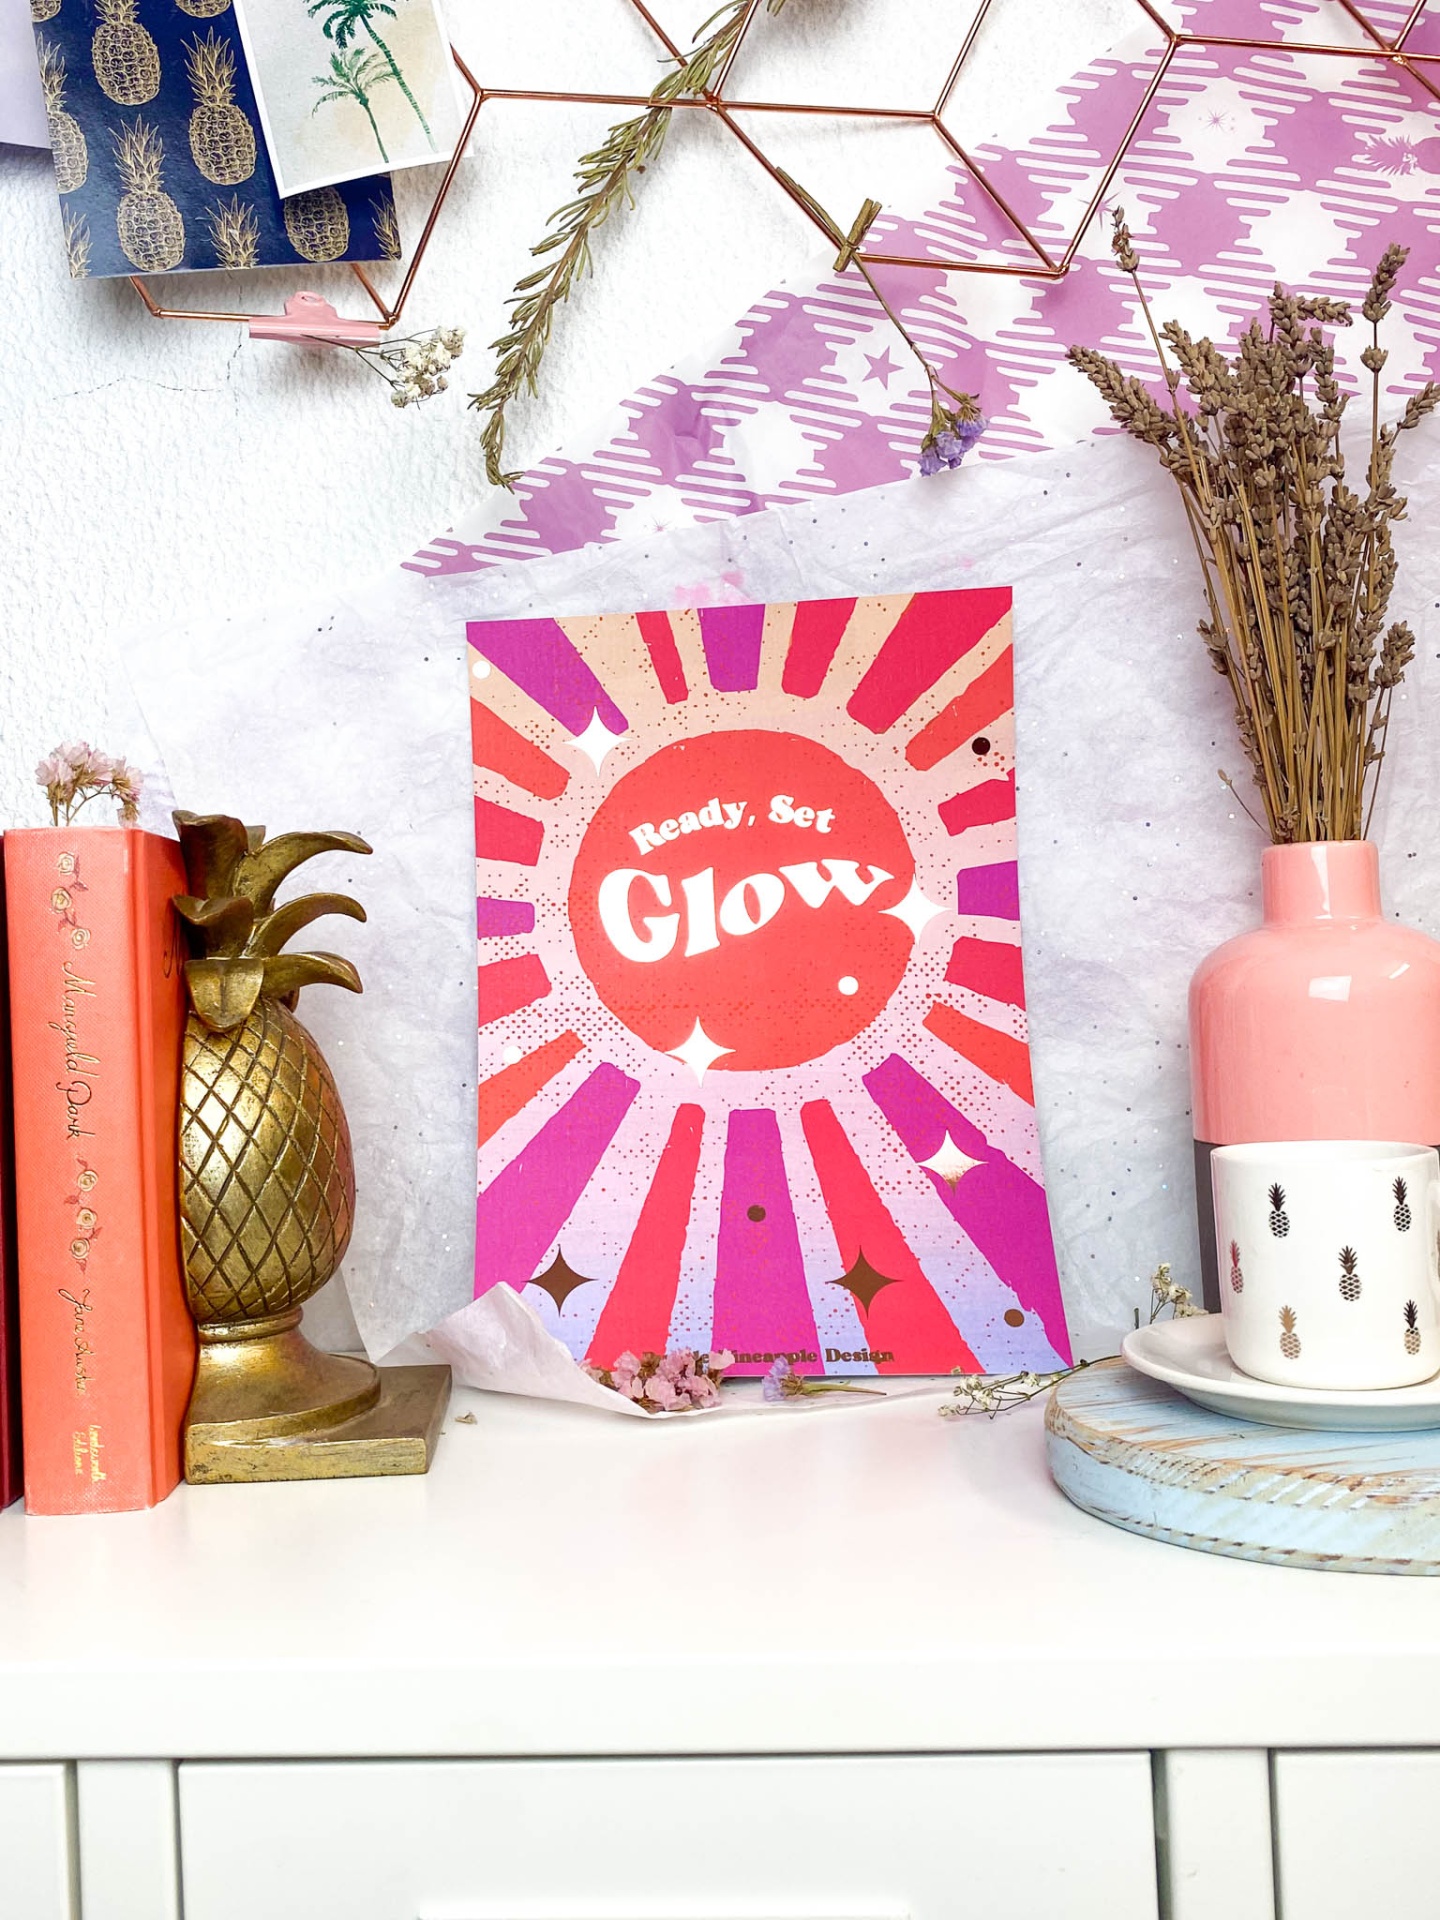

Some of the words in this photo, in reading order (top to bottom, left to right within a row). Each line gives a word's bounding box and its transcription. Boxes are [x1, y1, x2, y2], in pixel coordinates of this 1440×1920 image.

[628, 797, 756, 856] Ready,
[768, 794, 836, 833] Set
[598, 858, 895, 963] Glow
[55, 1080, 97, 1141] Park
[57, 1288, 94, 1334] Jane
[718, 1348, 818, 1365] ineaple
[825, 1347, 895, 1364] Design
